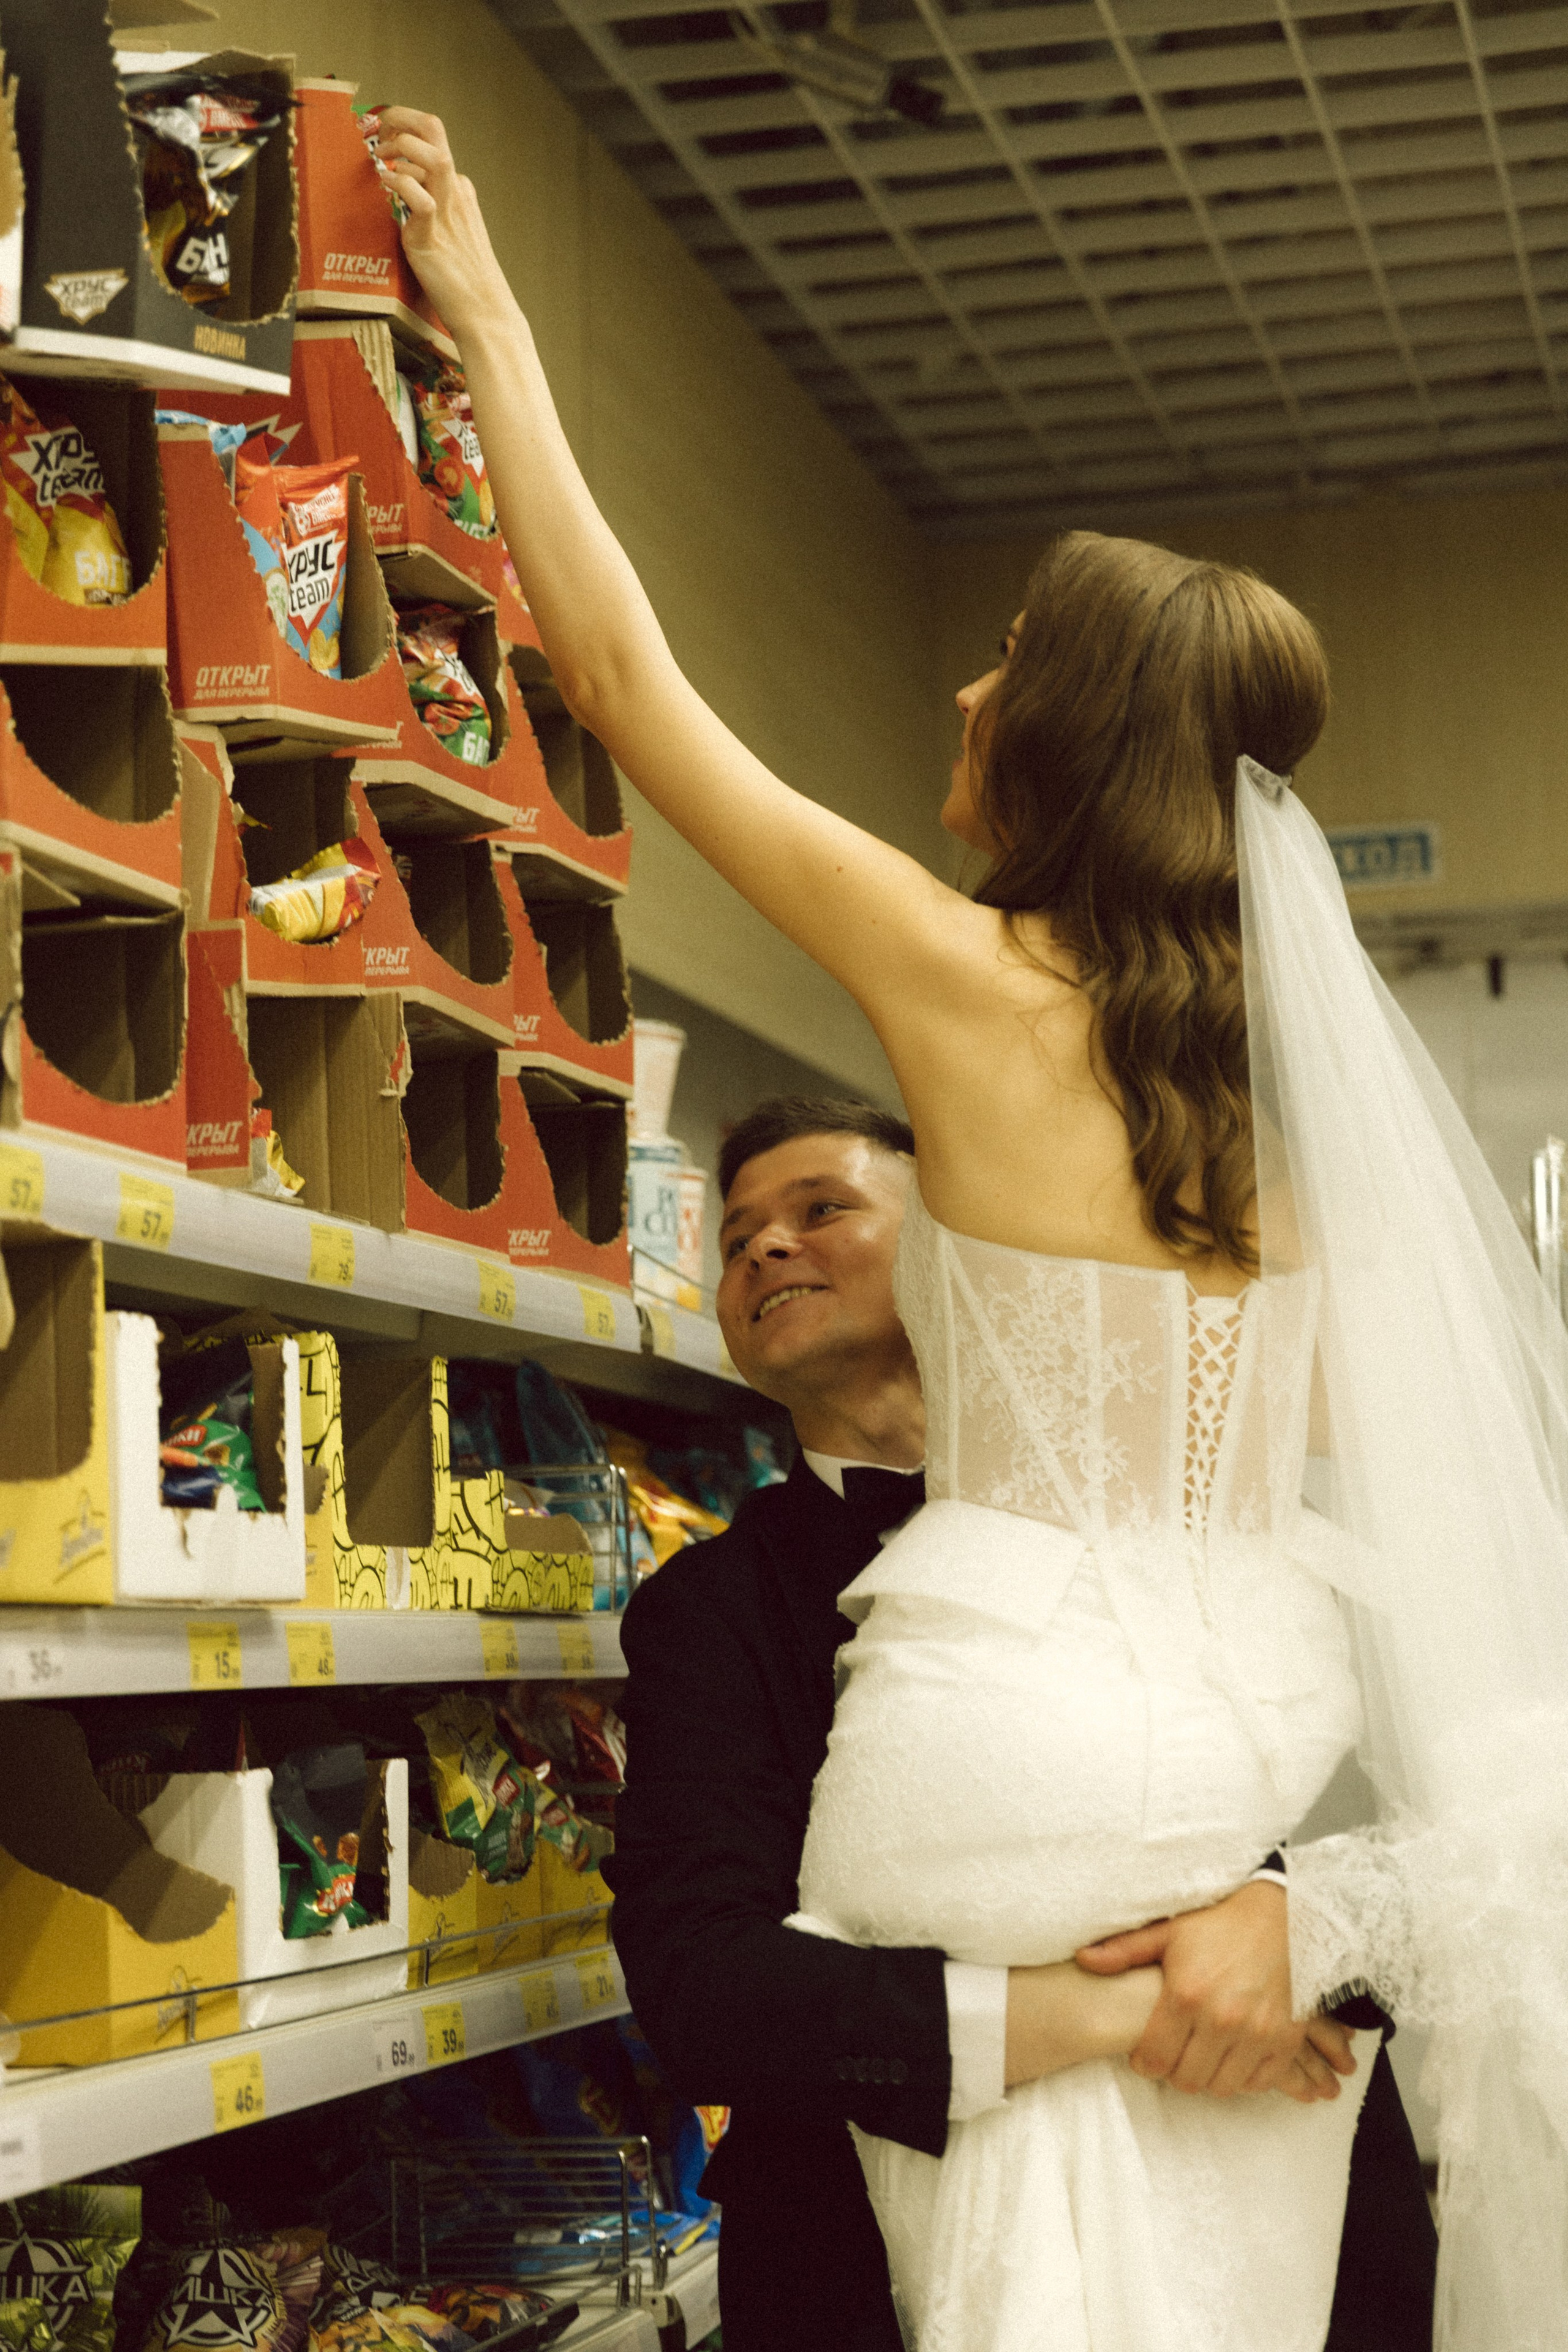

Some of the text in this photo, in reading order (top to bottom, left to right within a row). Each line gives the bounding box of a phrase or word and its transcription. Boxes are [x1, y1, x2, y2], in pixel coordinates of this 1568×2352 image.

[324, 252, 391, 276] ОТКРЫТ
[194, 325, 245, 360] НОВИНКА
[290, 577, 330, 612] team
[196, 664, 271, 687] ОТКРЫТ
[364, 947, 410, 965] КРЫТ
[186, 1121, 243, 1145] КРЫТ
[140, 1209, 160, 1240] 57
[494, 1289, 508, 1314] 57
[216, 1651, 230, 1679] 15
[318, 1657, 329, 1676] 48
[392, 2041, 407, 2066] 69
[442, 2029, 457, 2054] 39
[236, 2084, 254, 2113] 46
